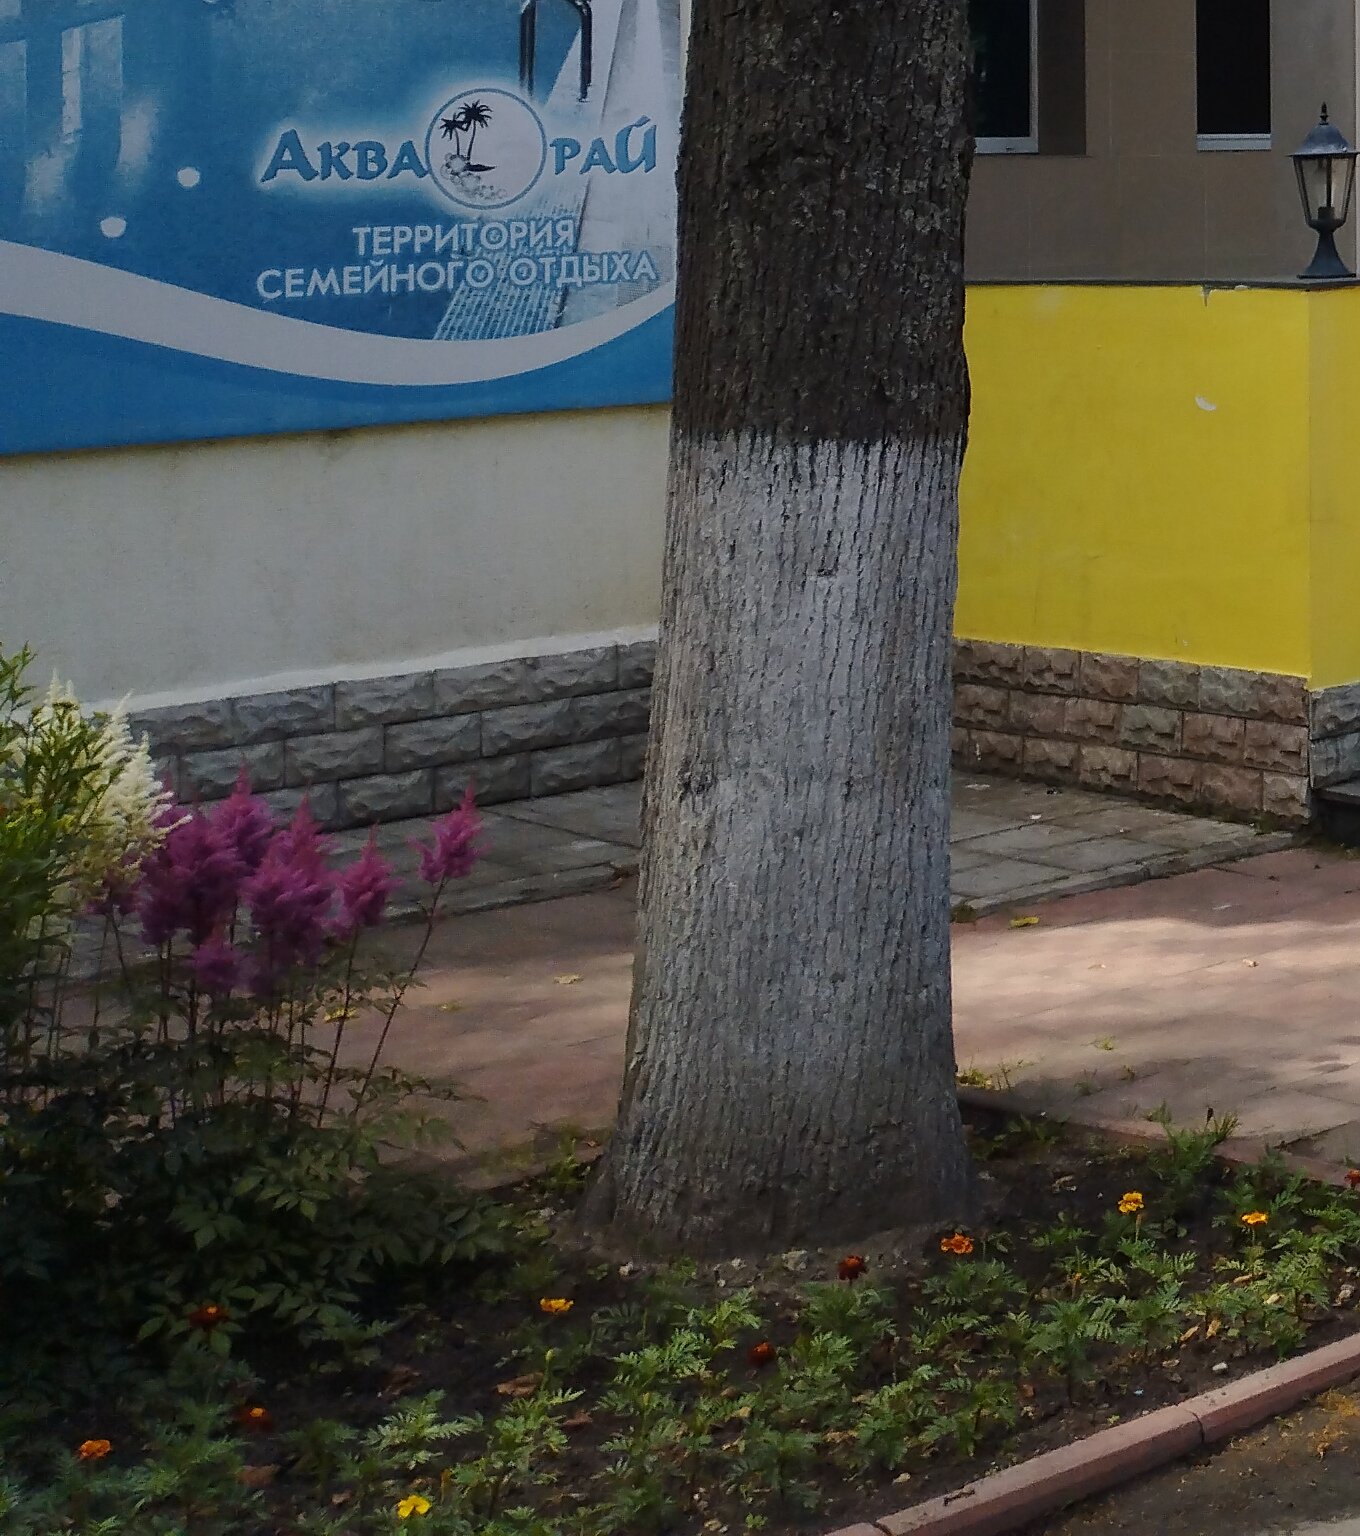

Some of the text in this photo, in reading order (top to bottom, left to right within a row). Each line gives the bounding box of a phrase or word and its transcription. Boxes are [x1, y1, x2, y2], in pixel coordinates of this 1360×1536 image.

[352, 217, 577, 256] ТЕРРИТОРИЯ
[256, 250, 658, 302] СЕМЕЙНОГО ОТДЫХА
